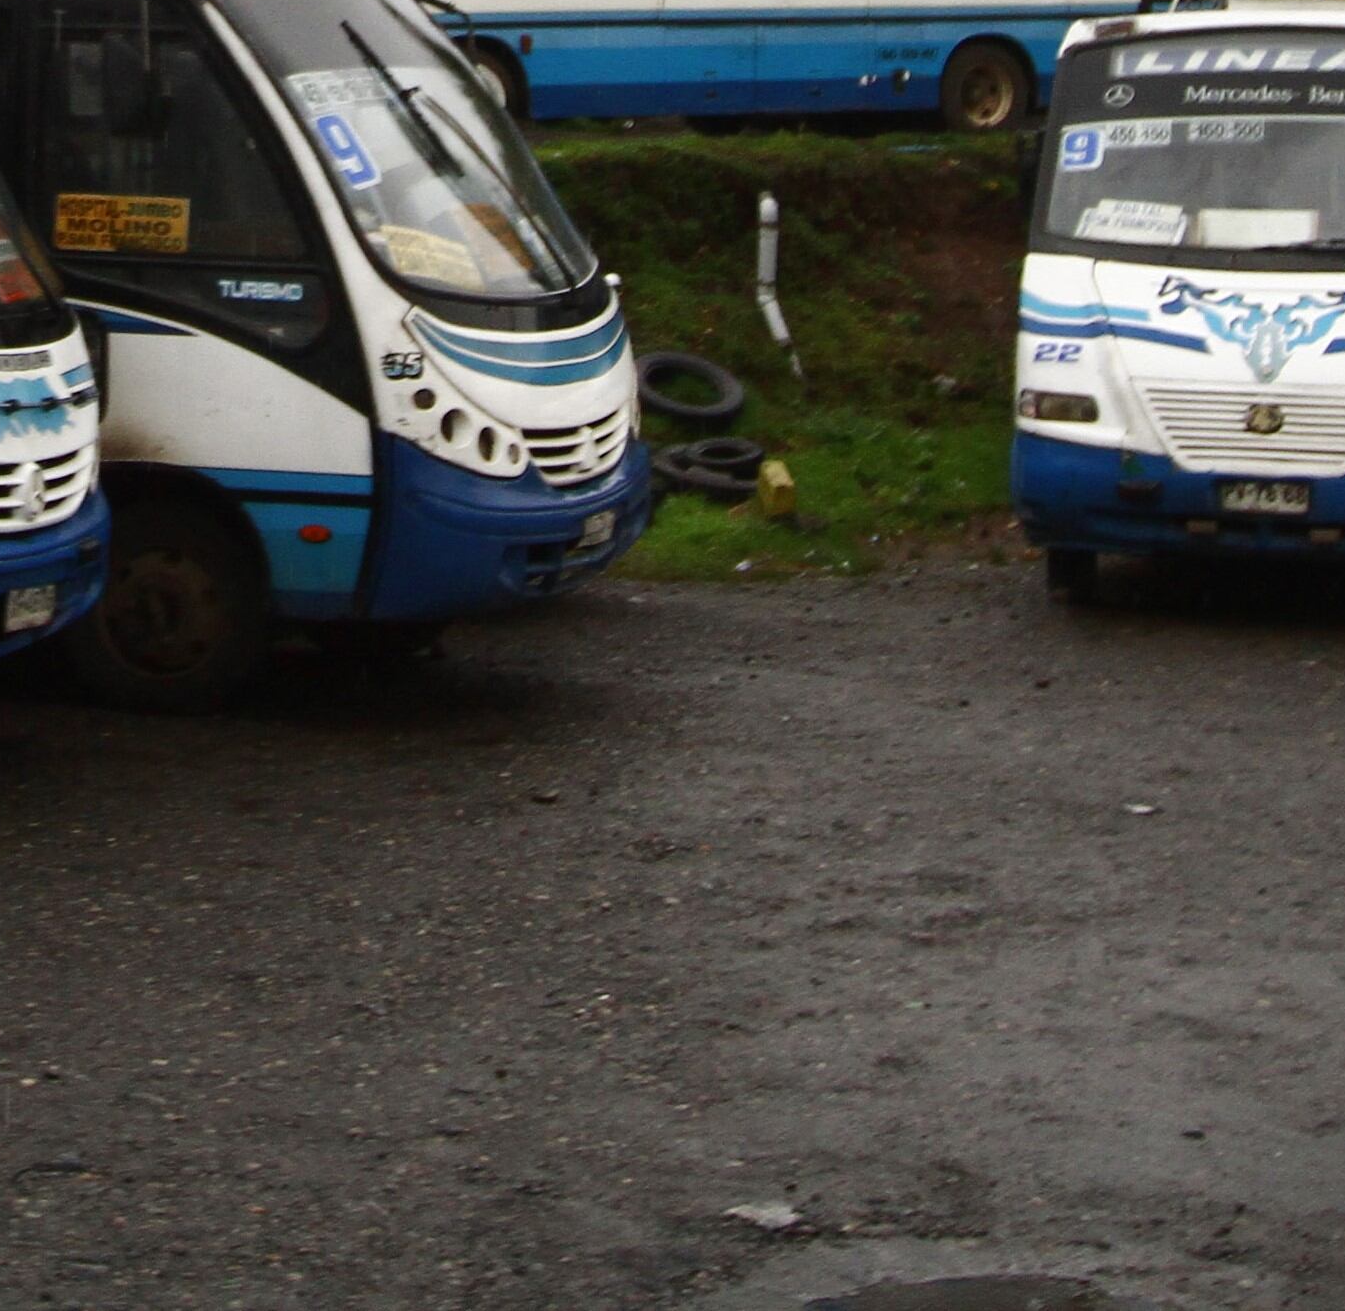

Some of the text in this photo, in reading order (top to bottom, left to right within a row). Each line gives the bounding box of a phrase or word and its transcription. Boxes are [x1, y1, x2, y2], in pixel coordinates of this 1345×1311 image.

[316, 114, 377, 185] 9
[1062, 129, 1101, 167] 9
[66, 218, 173, 236] MOLINO
[218, 279, 304, 301] TURISMO
[1032, 342, 1084, 362] 22
[380, 351, 424, 380] 35
